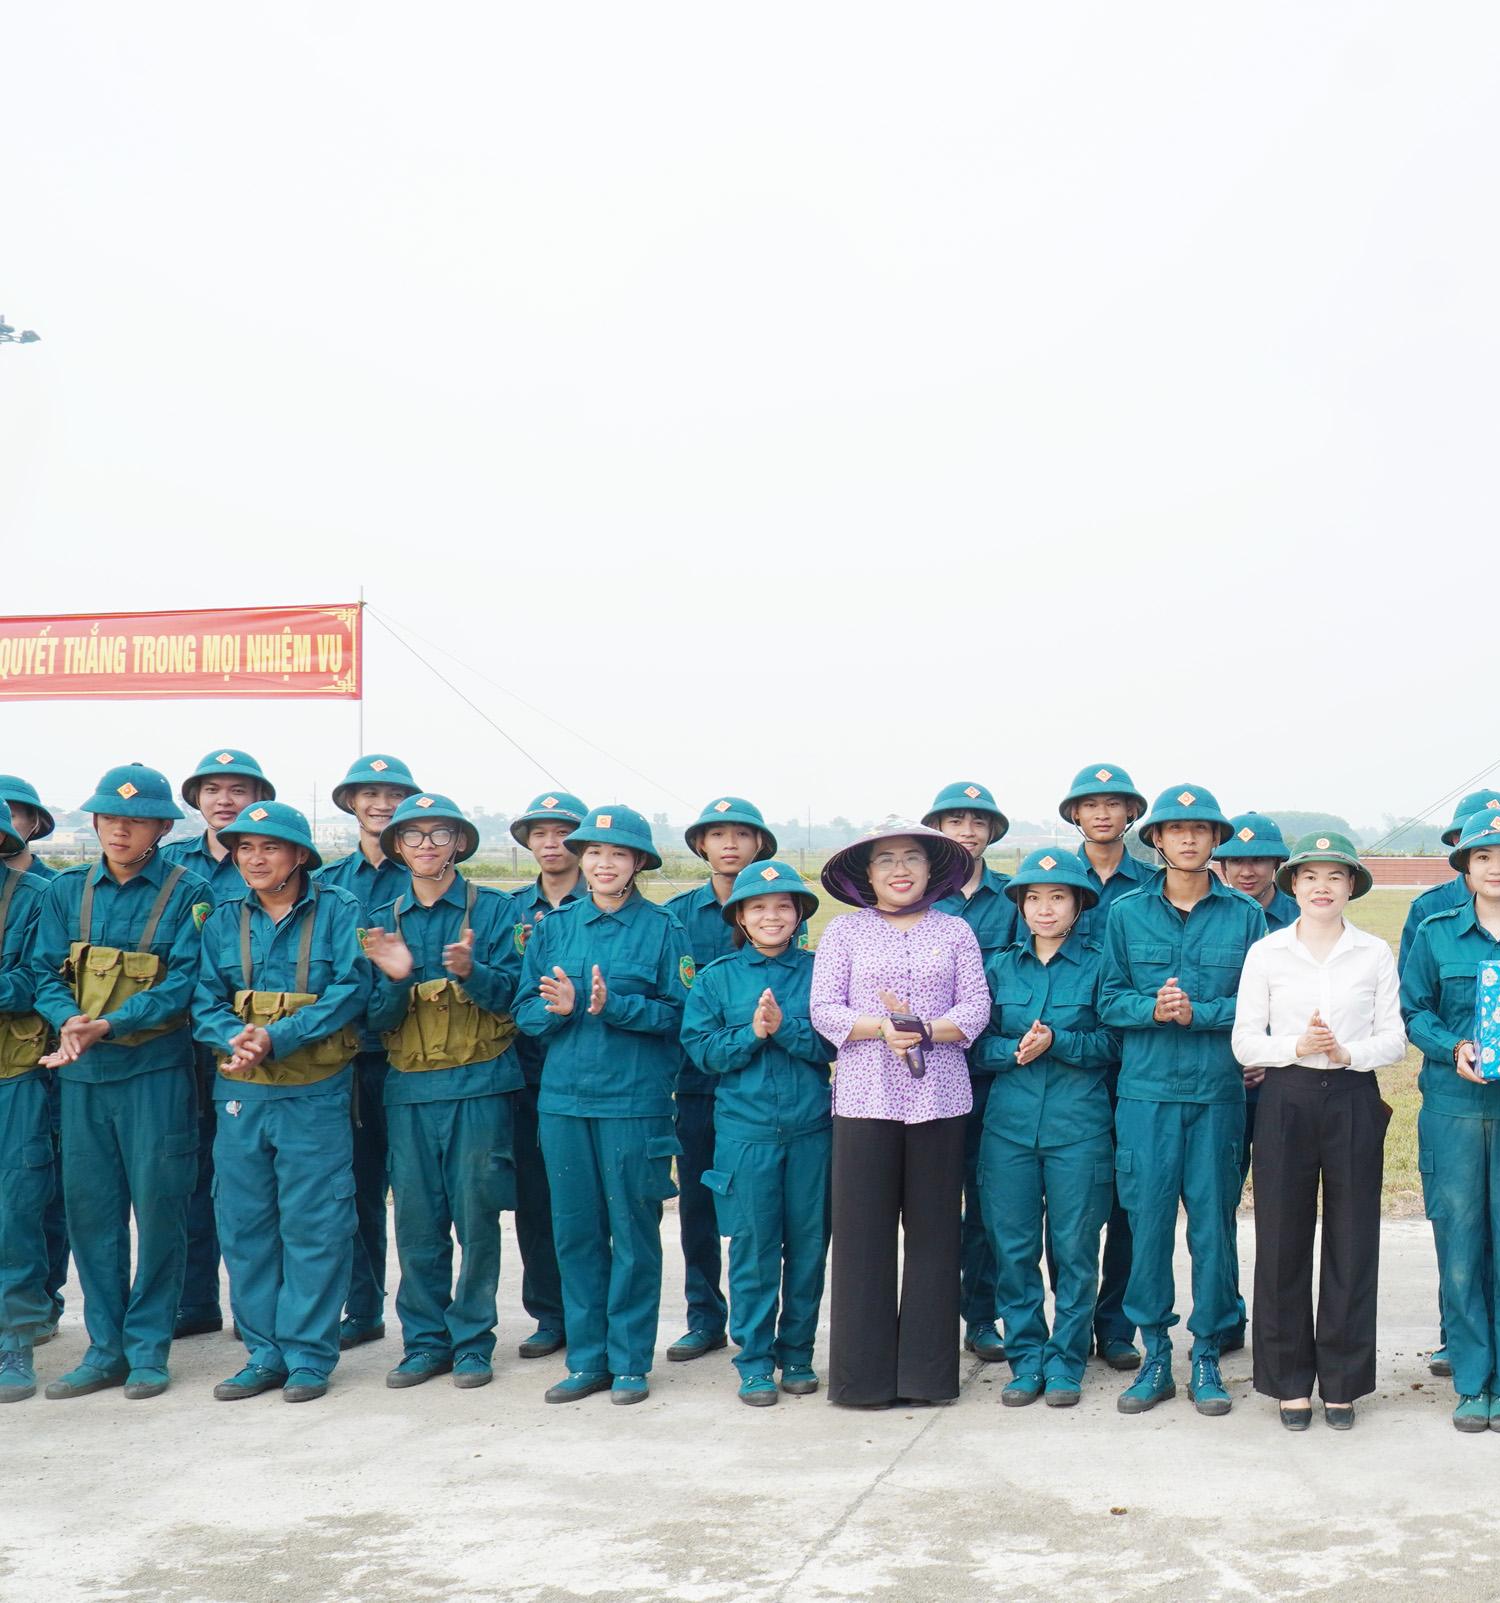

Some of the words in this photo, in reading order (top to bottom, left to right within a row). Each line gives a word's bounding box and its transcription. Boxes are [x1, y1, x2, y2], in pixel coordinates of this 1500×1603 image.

[0, 625, 57, 679] QUYẾT
[64, 623, 126, 674] THẮNG
[132, 634, 196, 674] TRONG
[202, 634, 240, 681] MỌI
[246, 626, 310, 681] NHIỆM
[317, 634, 343, 681] VỤ
